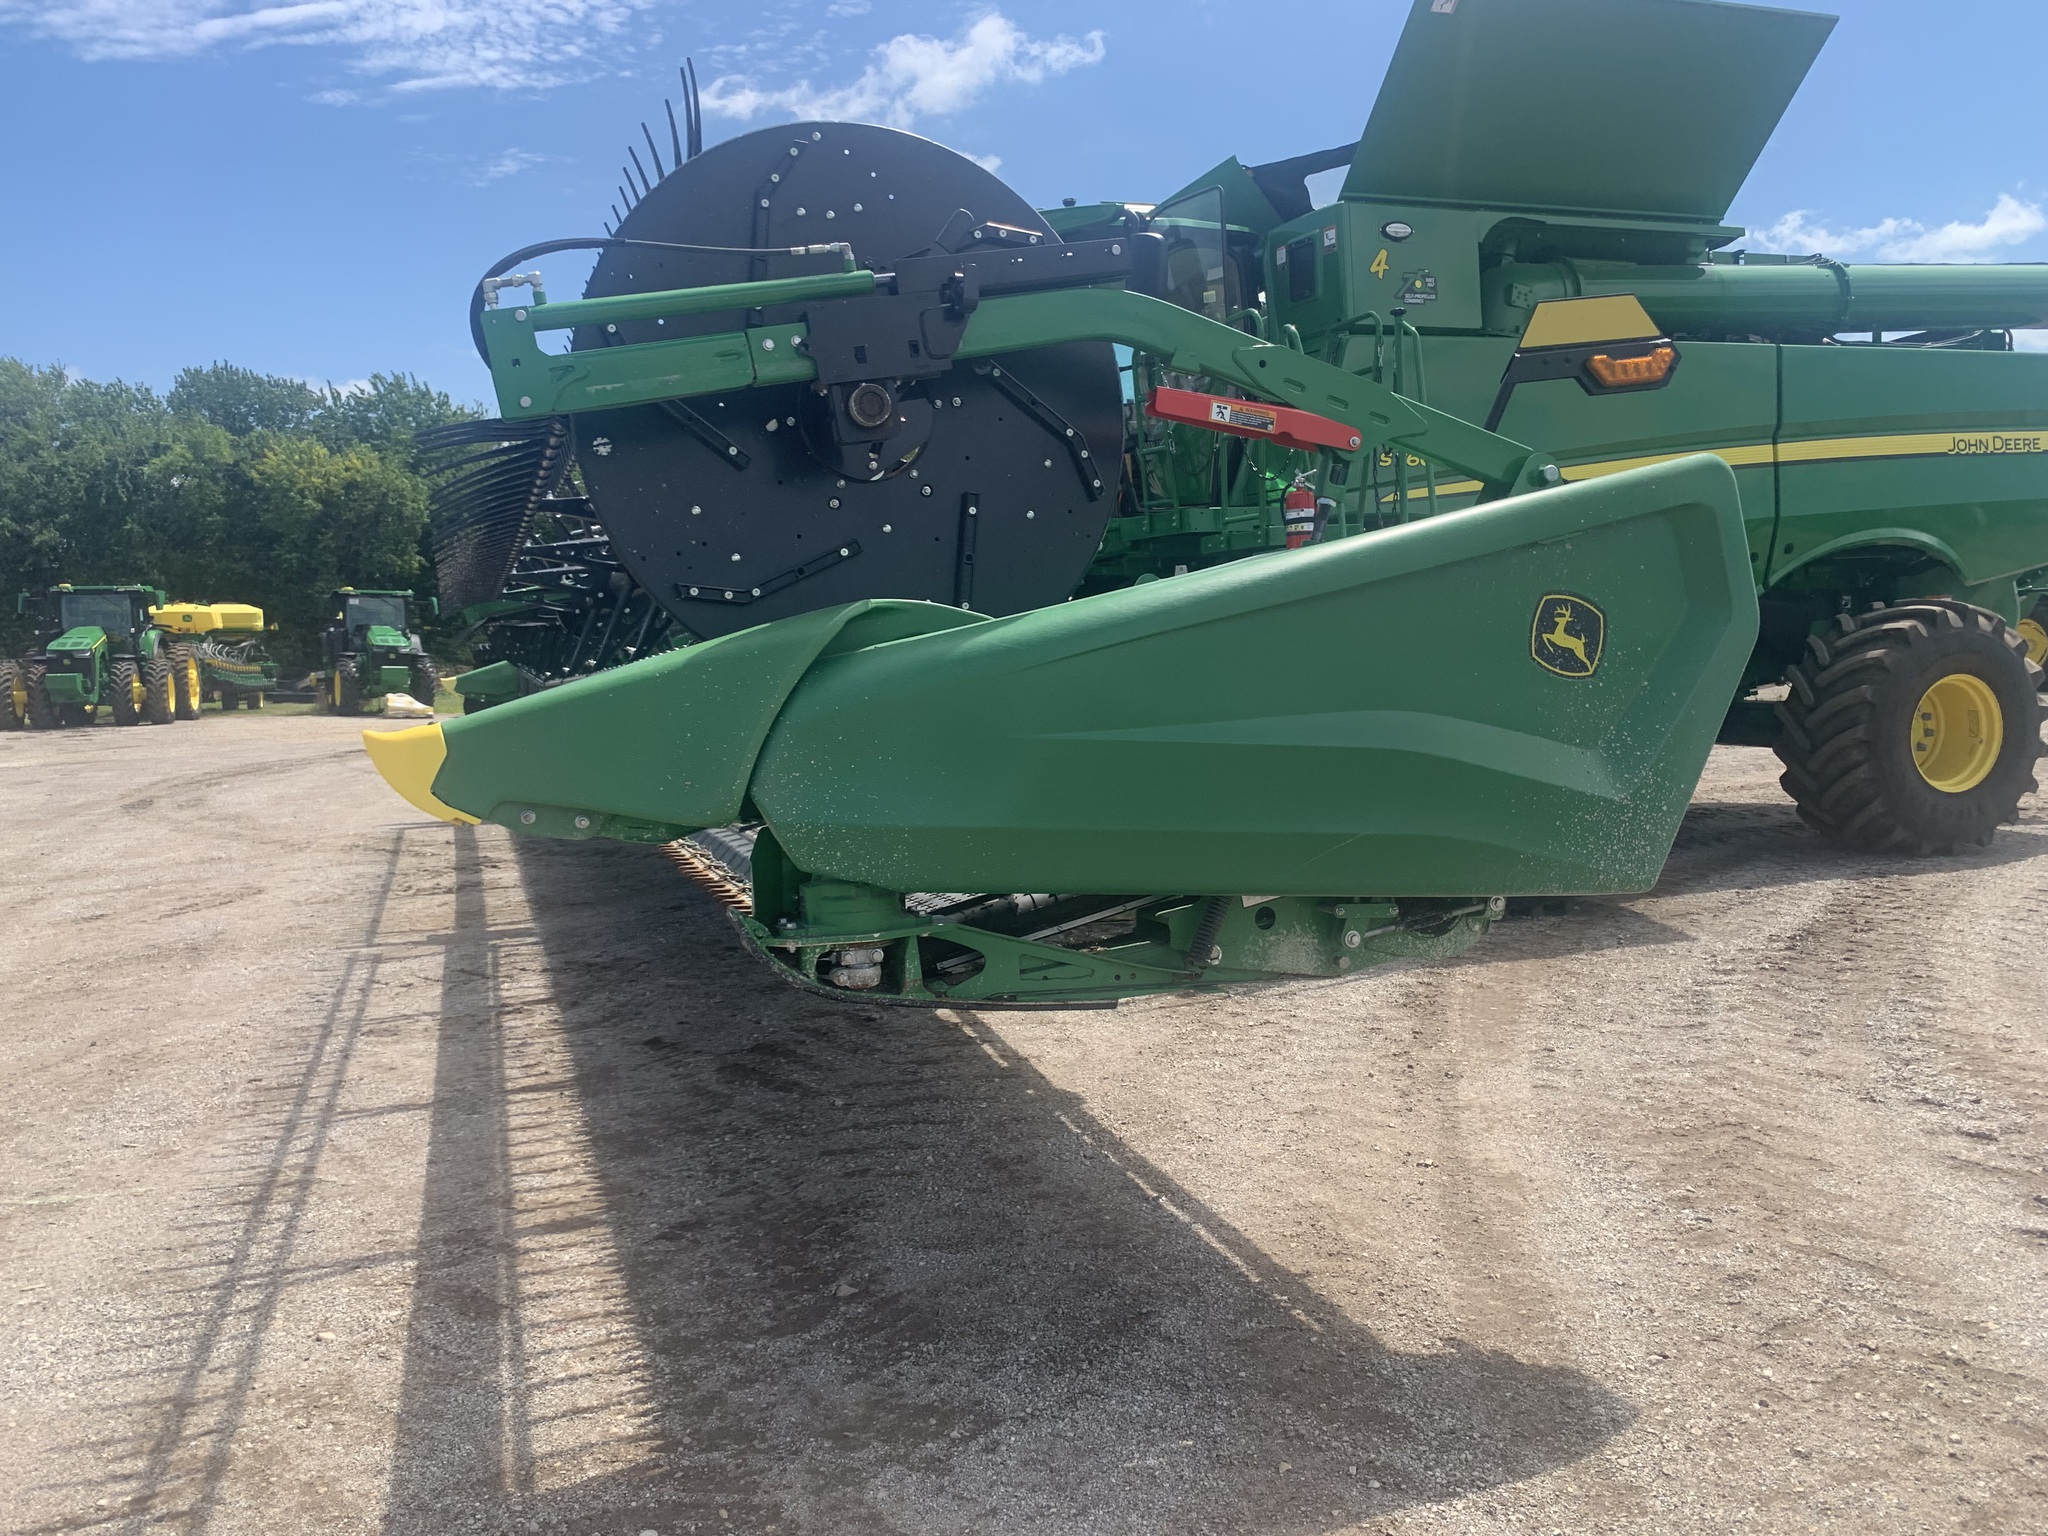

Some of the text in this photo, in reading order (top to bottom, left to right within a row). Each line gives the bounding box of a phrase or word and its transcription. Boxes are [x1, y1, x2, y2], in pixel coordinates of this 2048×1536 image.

[1370, 248, 1390, 280] 4
[1947, 435, 2042, 452] JOHN DEERE
